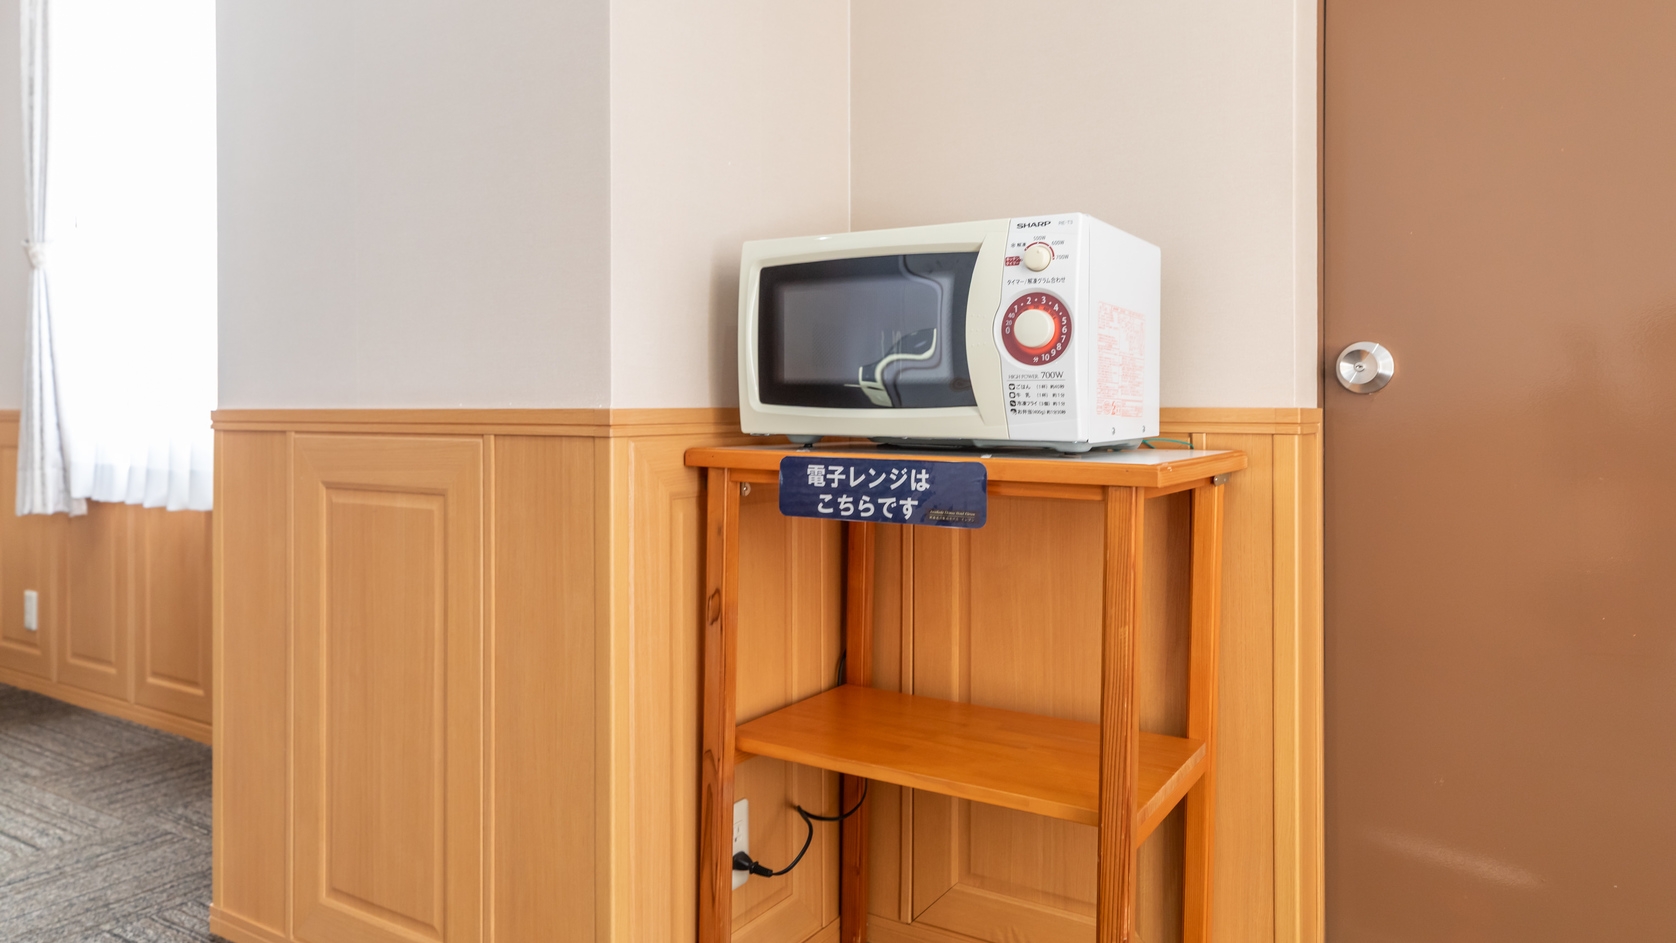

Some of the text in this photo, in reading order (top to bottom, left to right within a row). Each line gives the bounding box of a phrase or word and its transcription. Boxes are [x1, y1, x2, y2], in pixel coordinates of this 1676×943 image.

[1016, 220, 1052, 230] SHARP
[1026, 296, 1032, 305] 2
[1041, 295, 1047, 304] 3
[1014, 304, 1018, 313] 1
[1053, 303, 1059, 312] 4
[1061, 316, 1067, 325] 5
[1005, 326, 1011, 335] 0
[1061, 325, 1068, 334] 6
[1061, 334, 1066, 343] 7
[1056, 342, 1062, 351] 8
[1050, 348, 1057, 357] 9
[1041, 353, 1050, 362] 10
[1040, 371, 1064, 379] 700W
[806, 464, 930, 492] 電子レンジは
[817, 493, 919, 520] こちらです
